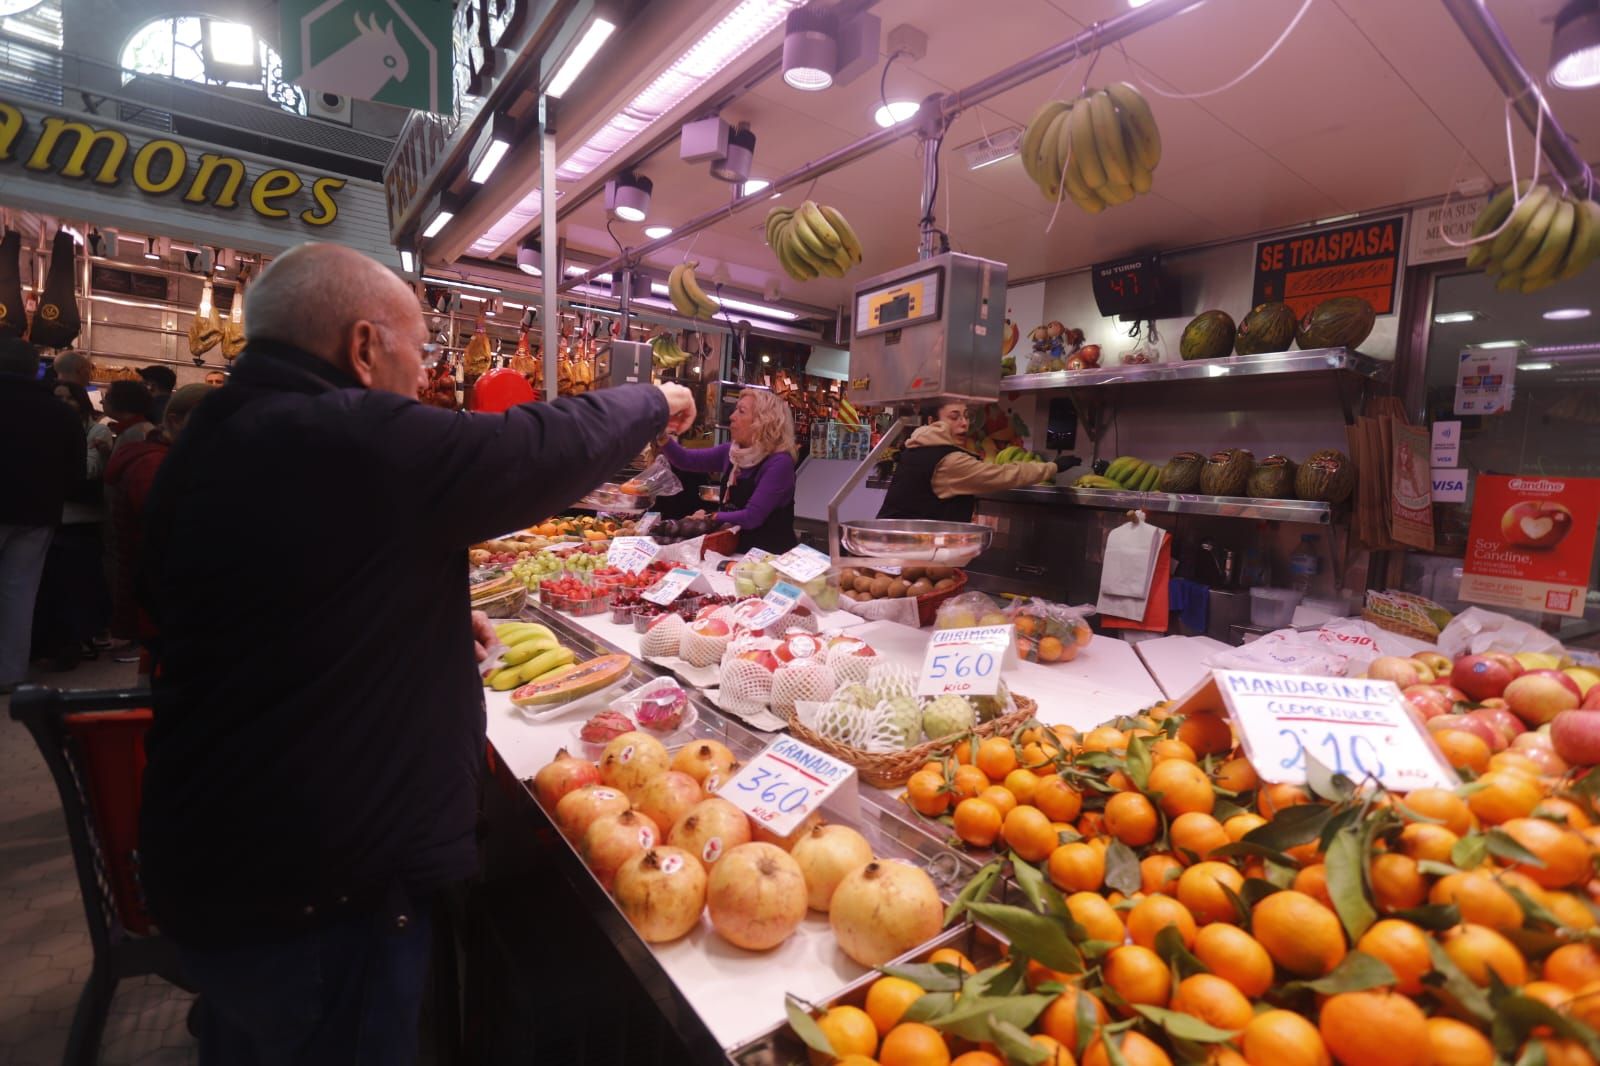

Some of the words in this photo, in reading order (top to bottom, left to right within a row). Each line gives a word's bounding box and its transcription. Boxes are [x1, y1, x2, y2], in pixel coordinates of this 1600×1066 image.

[1261, 244, 1284, 272] SE
[1290, 224, 1395, 267] TRASPASA
[1101, 269, 1112, 277] SU
[1113, 262, 1142, 273] TURNO
[1109, 272, 1141, 297] 47
[1432, 481, 1463, 491] VISA
[1510, 479, 1563, 492] Candine
[1475, 539, 1499, 551] Soy
[1474, 549, 1532, 565] Candine,
[930, 652, 993, 678] 5'60
[944, 683, 971, 692] KILO
[1228, 676, 1395, 703] MANDARINAS
[772, 740, 848, 782] GRANADAS
[737, 767, 809, 813] 3'60
